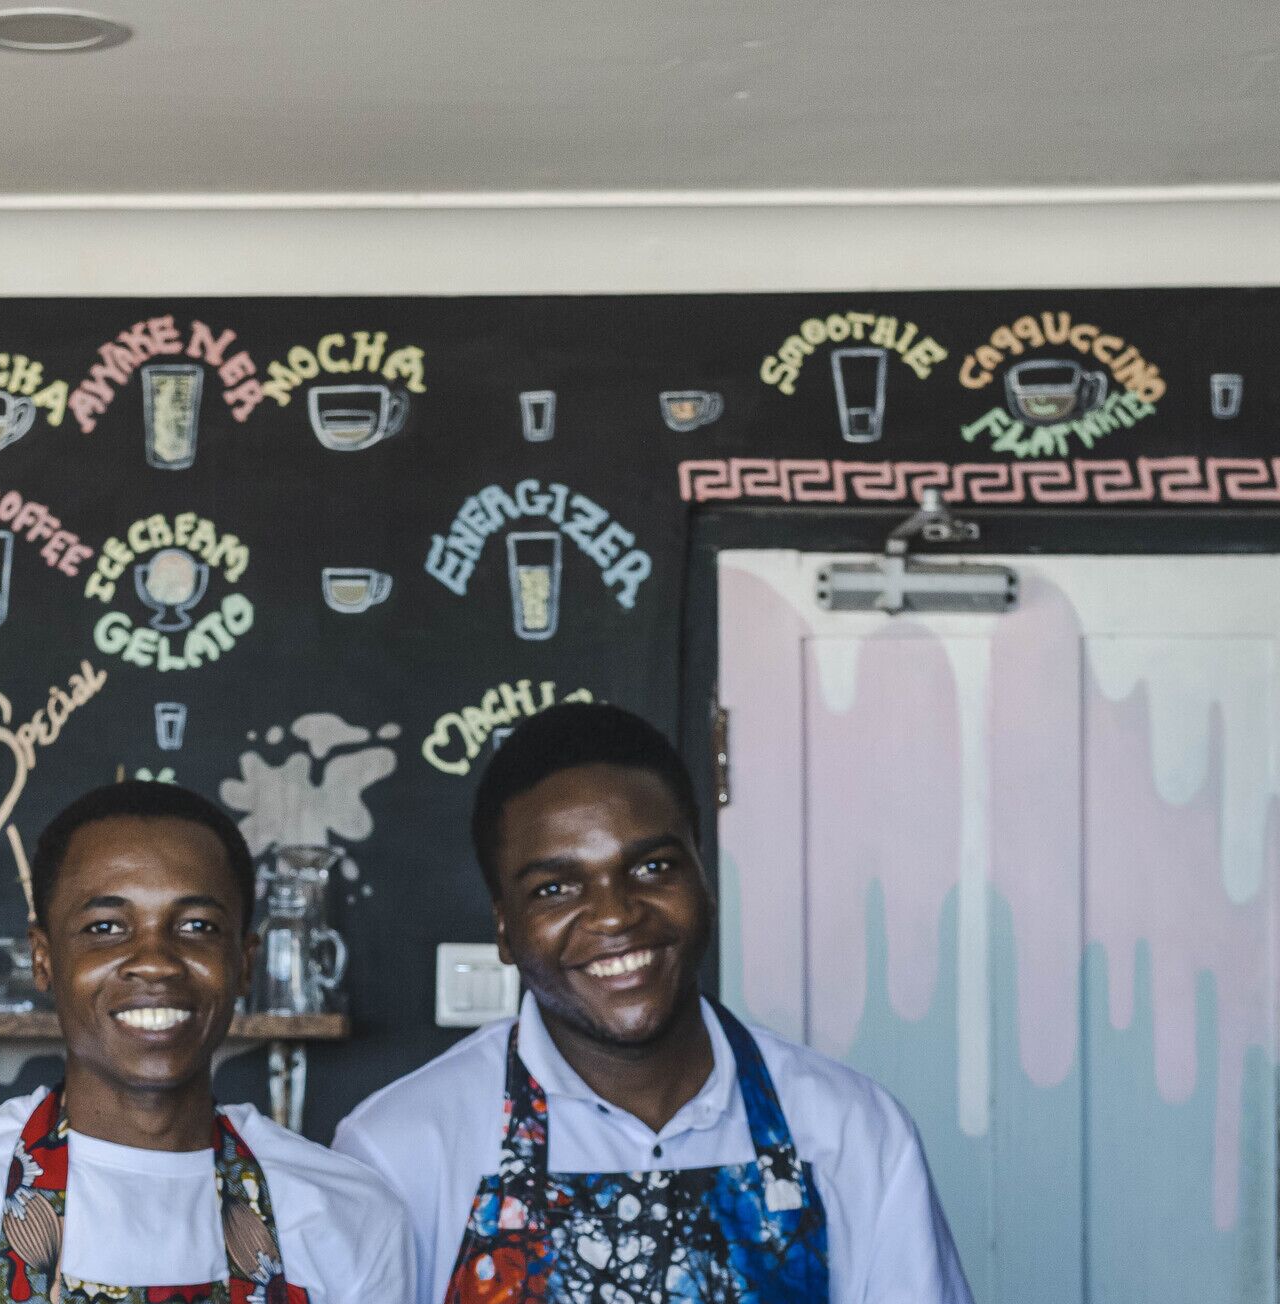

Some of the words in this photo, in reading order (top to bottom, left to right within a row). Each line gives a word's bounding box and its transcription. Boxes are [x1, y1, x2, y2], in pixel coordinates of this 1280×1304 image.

[67, 314, 265, 434] AWAKENER
[262, 331, 427, 406] MOCHA
[760, 311, 949, 395] SMOOTHIE
[960, 407, 1072, 459] FLAT
[84, 534, 129, 603] ICE
[127, 511, 250, 584] CREAM
[425, 478, 652, 609] ENERGIZER
[93, 591, 255, 672] GELATO
